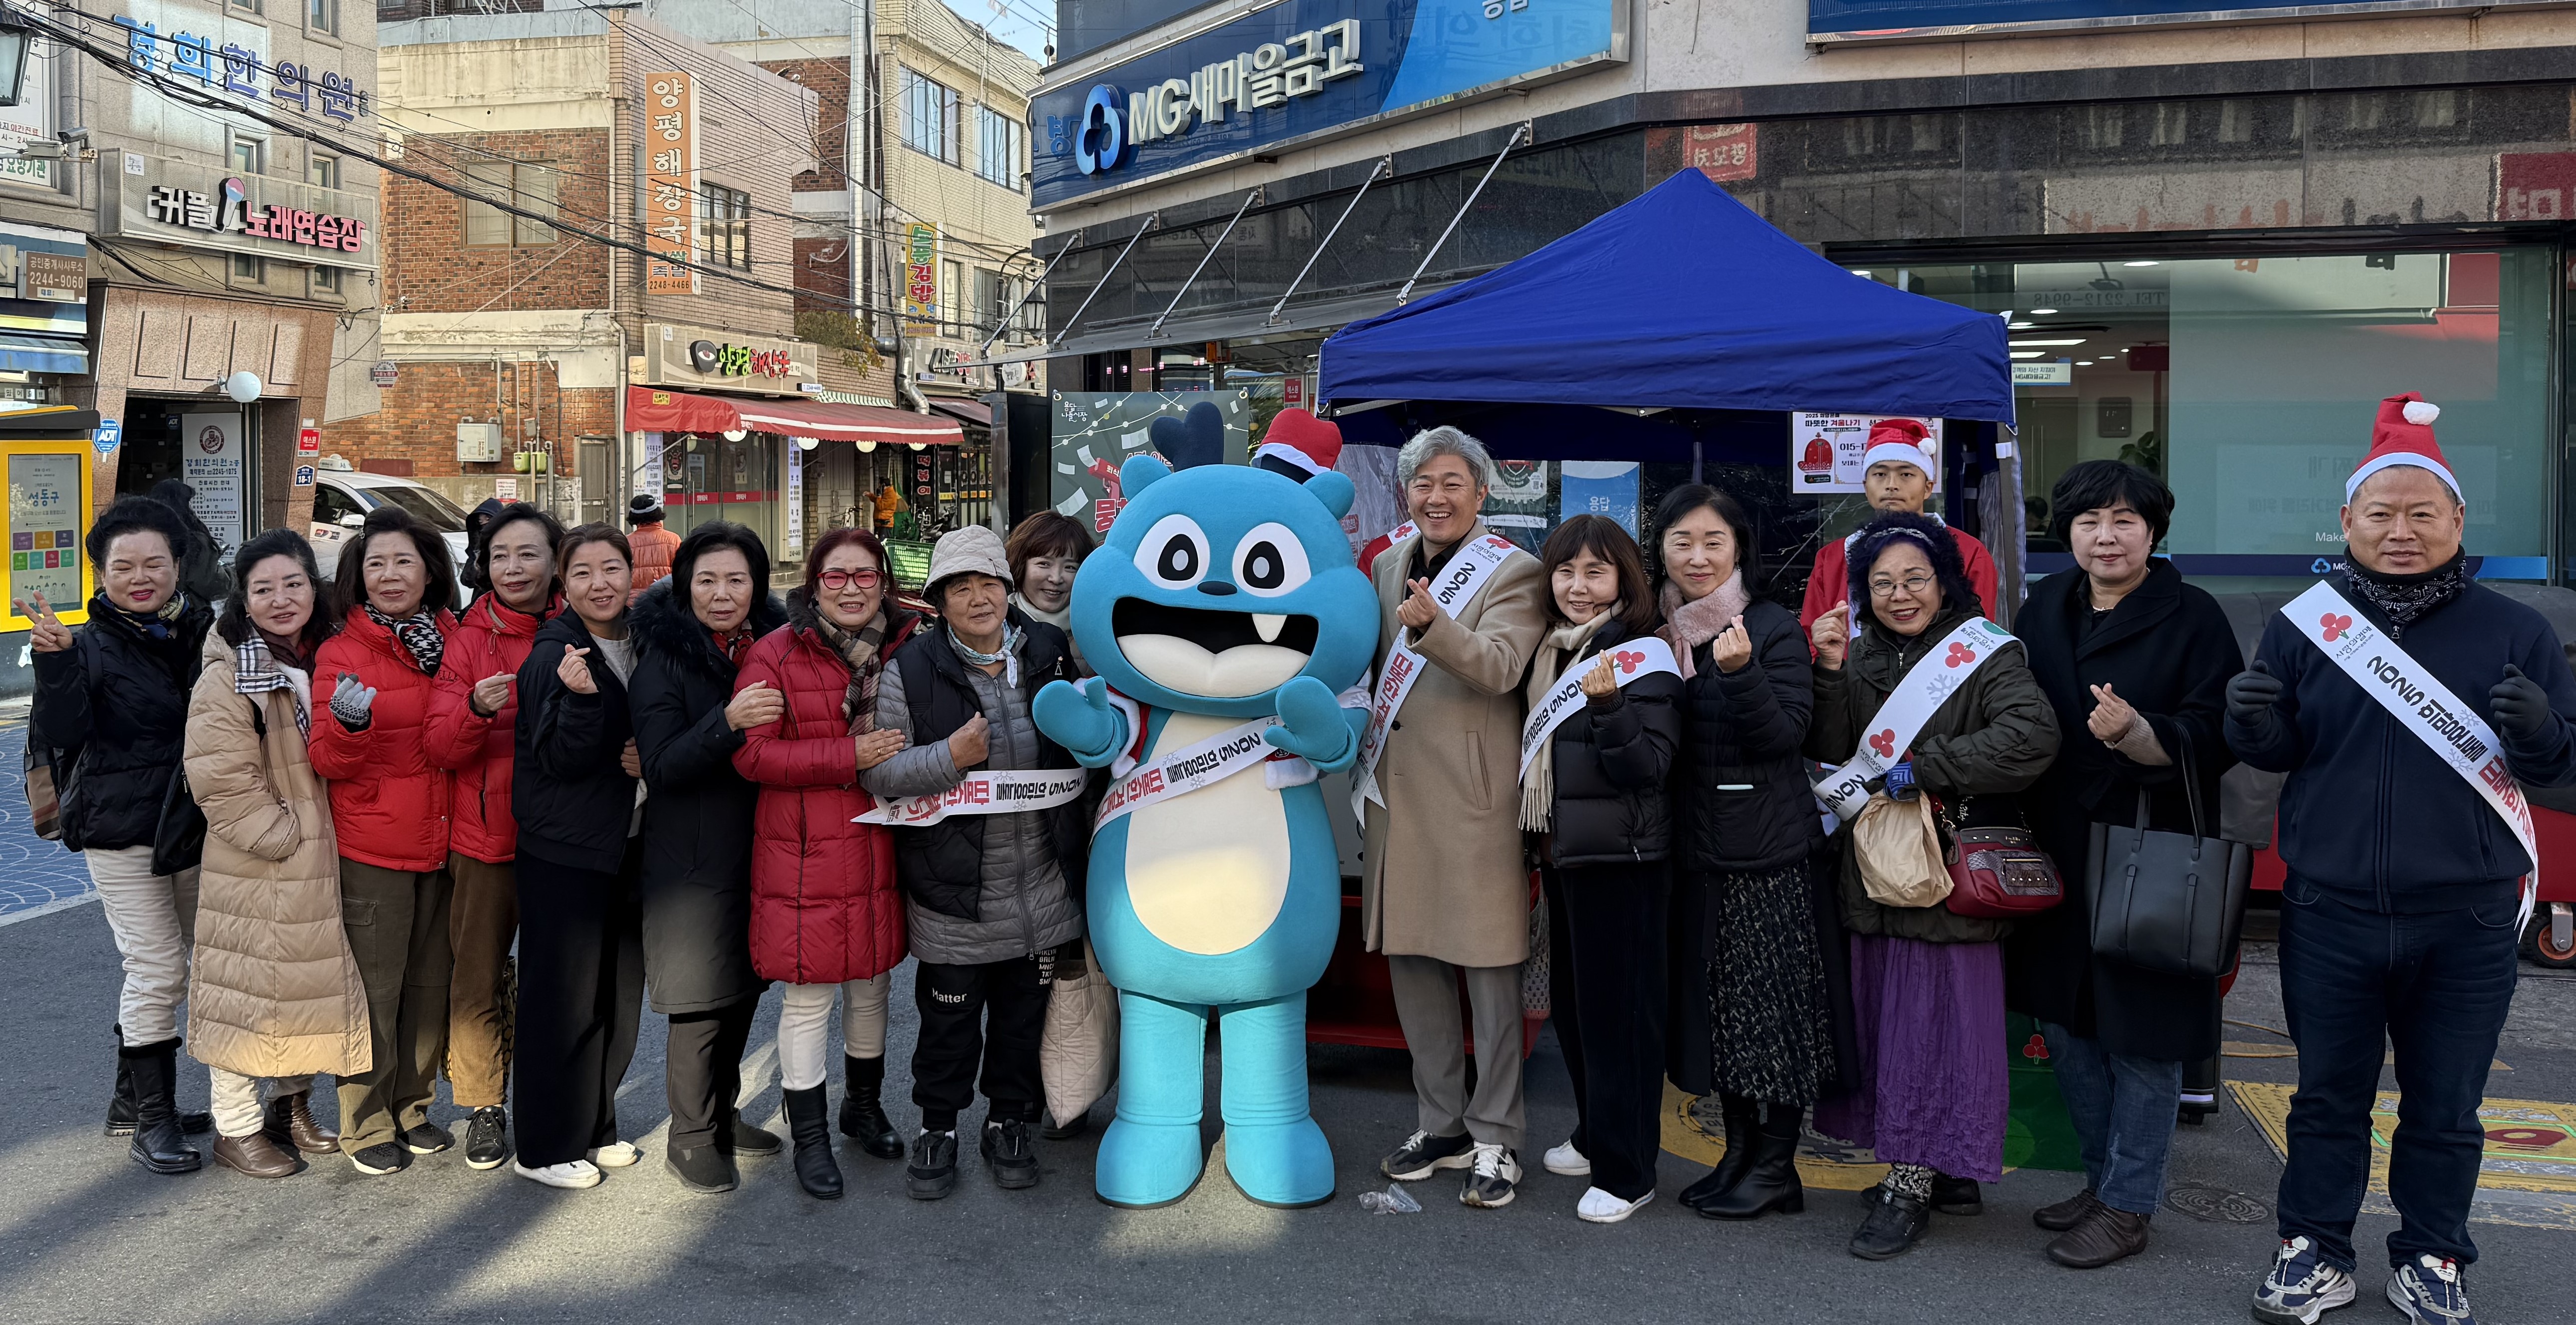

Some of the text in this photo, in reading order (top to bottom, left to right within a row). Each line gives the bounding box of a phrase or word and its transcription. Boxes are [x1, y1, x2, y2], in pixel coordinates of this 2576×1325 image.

[113, 14, 355, 122] 경희한의원
[1128, 18, 1363, 145] MG새마을금고
[652, 77, 686, 245] 양평해장국
[152, 185, 366, 252] 커플 노래연습장
[30, 257, 83, 272] 공인중개사사무소
[30, 272, 83, 289] 2244-9060
[650, 281, 689, 289] 2248-4466
[98, 430, 117, 442] ADT
[186, 458, 227, 467] 경희한의원
[298, 475, 311, 484] 18-1
[28, 489, 59, 507] 성동구
[1589, 496, 1610, 512] 용답
[2316, 532, 2346, 542] Make
[1438, 562, 1476, 604] 2025
[2336, 626, 2372, 658] 사랑의열매
[1383, 652, 1413, 702] 따뜻한
[2367, 655, 2426, 706] 2025
[2417, 698, 2489, 763] 희망온돌
[1218, 732, 1261, 762] 2025
[1048, 775, 1083, 796] 2025
[1127, 767, 1165, 802] 따뜻한
[932, 987, 967, 1004] Matter
